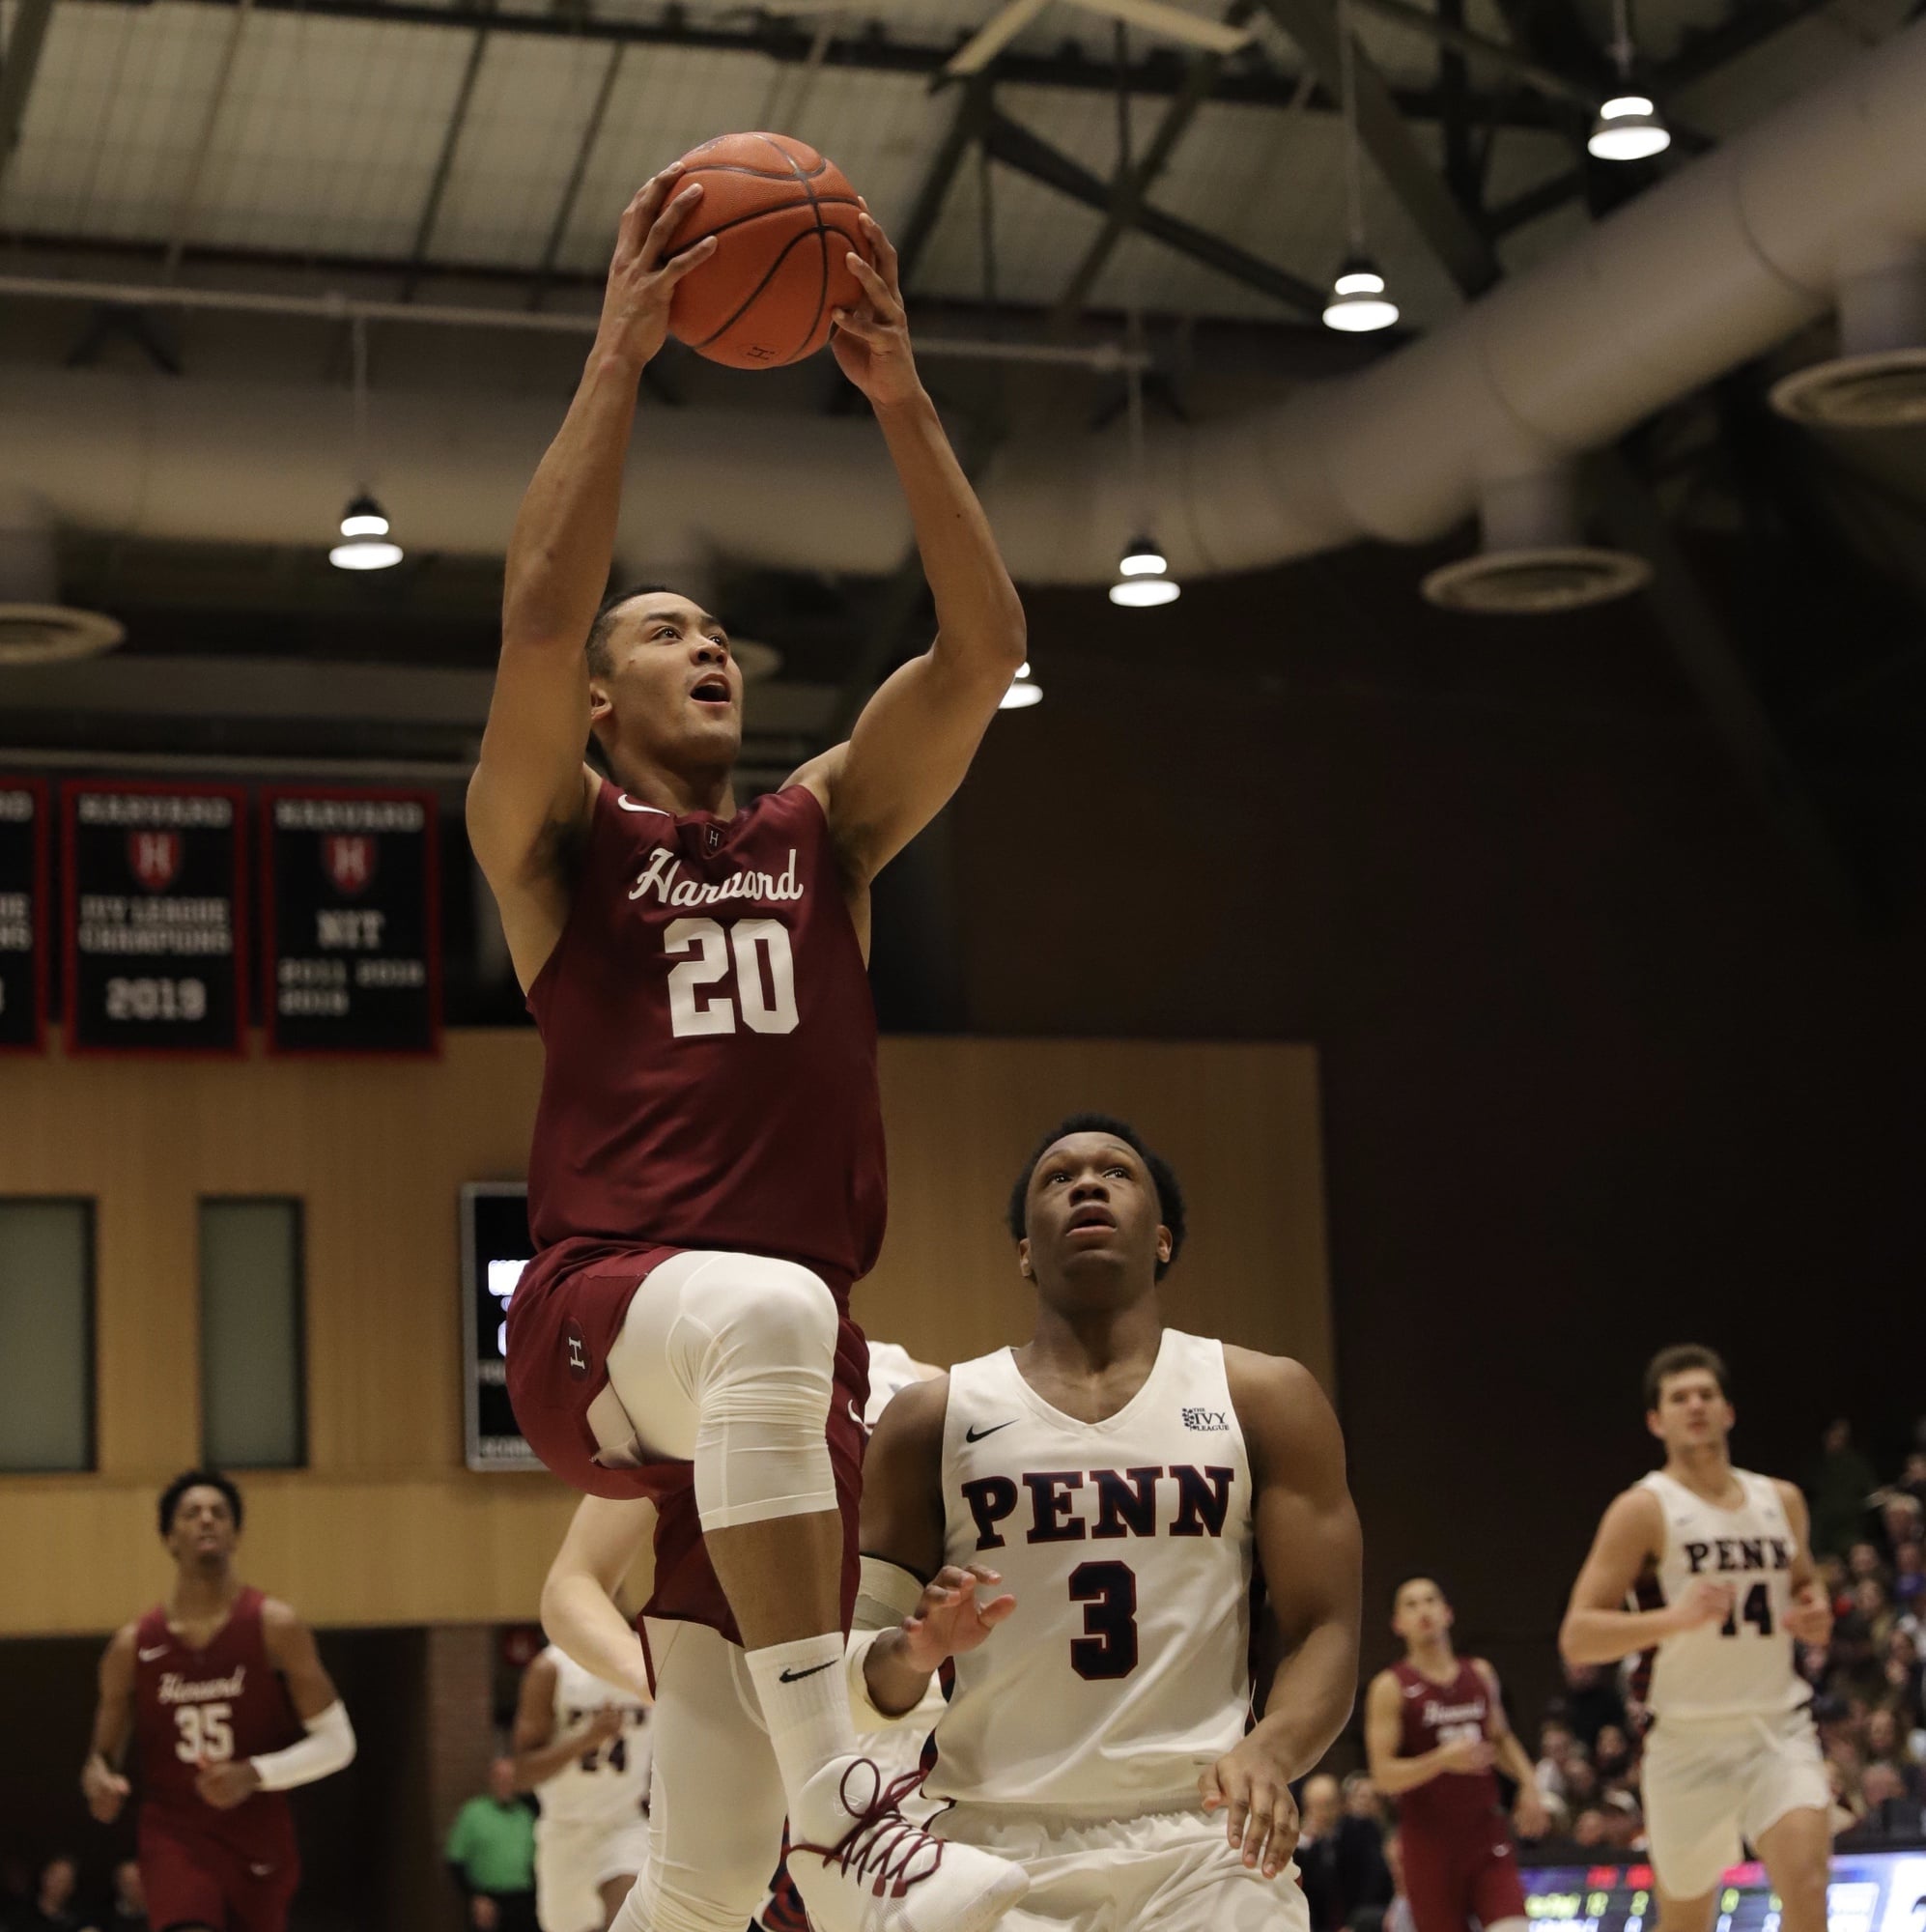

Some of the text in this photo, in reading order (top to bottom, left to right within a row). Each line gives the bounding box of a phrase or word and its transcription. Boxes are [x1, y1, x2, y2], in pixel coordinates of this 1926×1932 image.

[79, 794, 231, 827] HARVARD
[275, 799, 423, 832] HARVARD
[629, 848, 804, 906] Harvard
[105, 977, 207, 1020] 2019
[664, 918, 800, 1037] 20
[1194, 1412, 1226, 1425] IVY
[961, 1464, 1234, 1551] PENN
[1068, 1560, 1139, 1681] 3
[174, 1702, 235, 1764] 35
